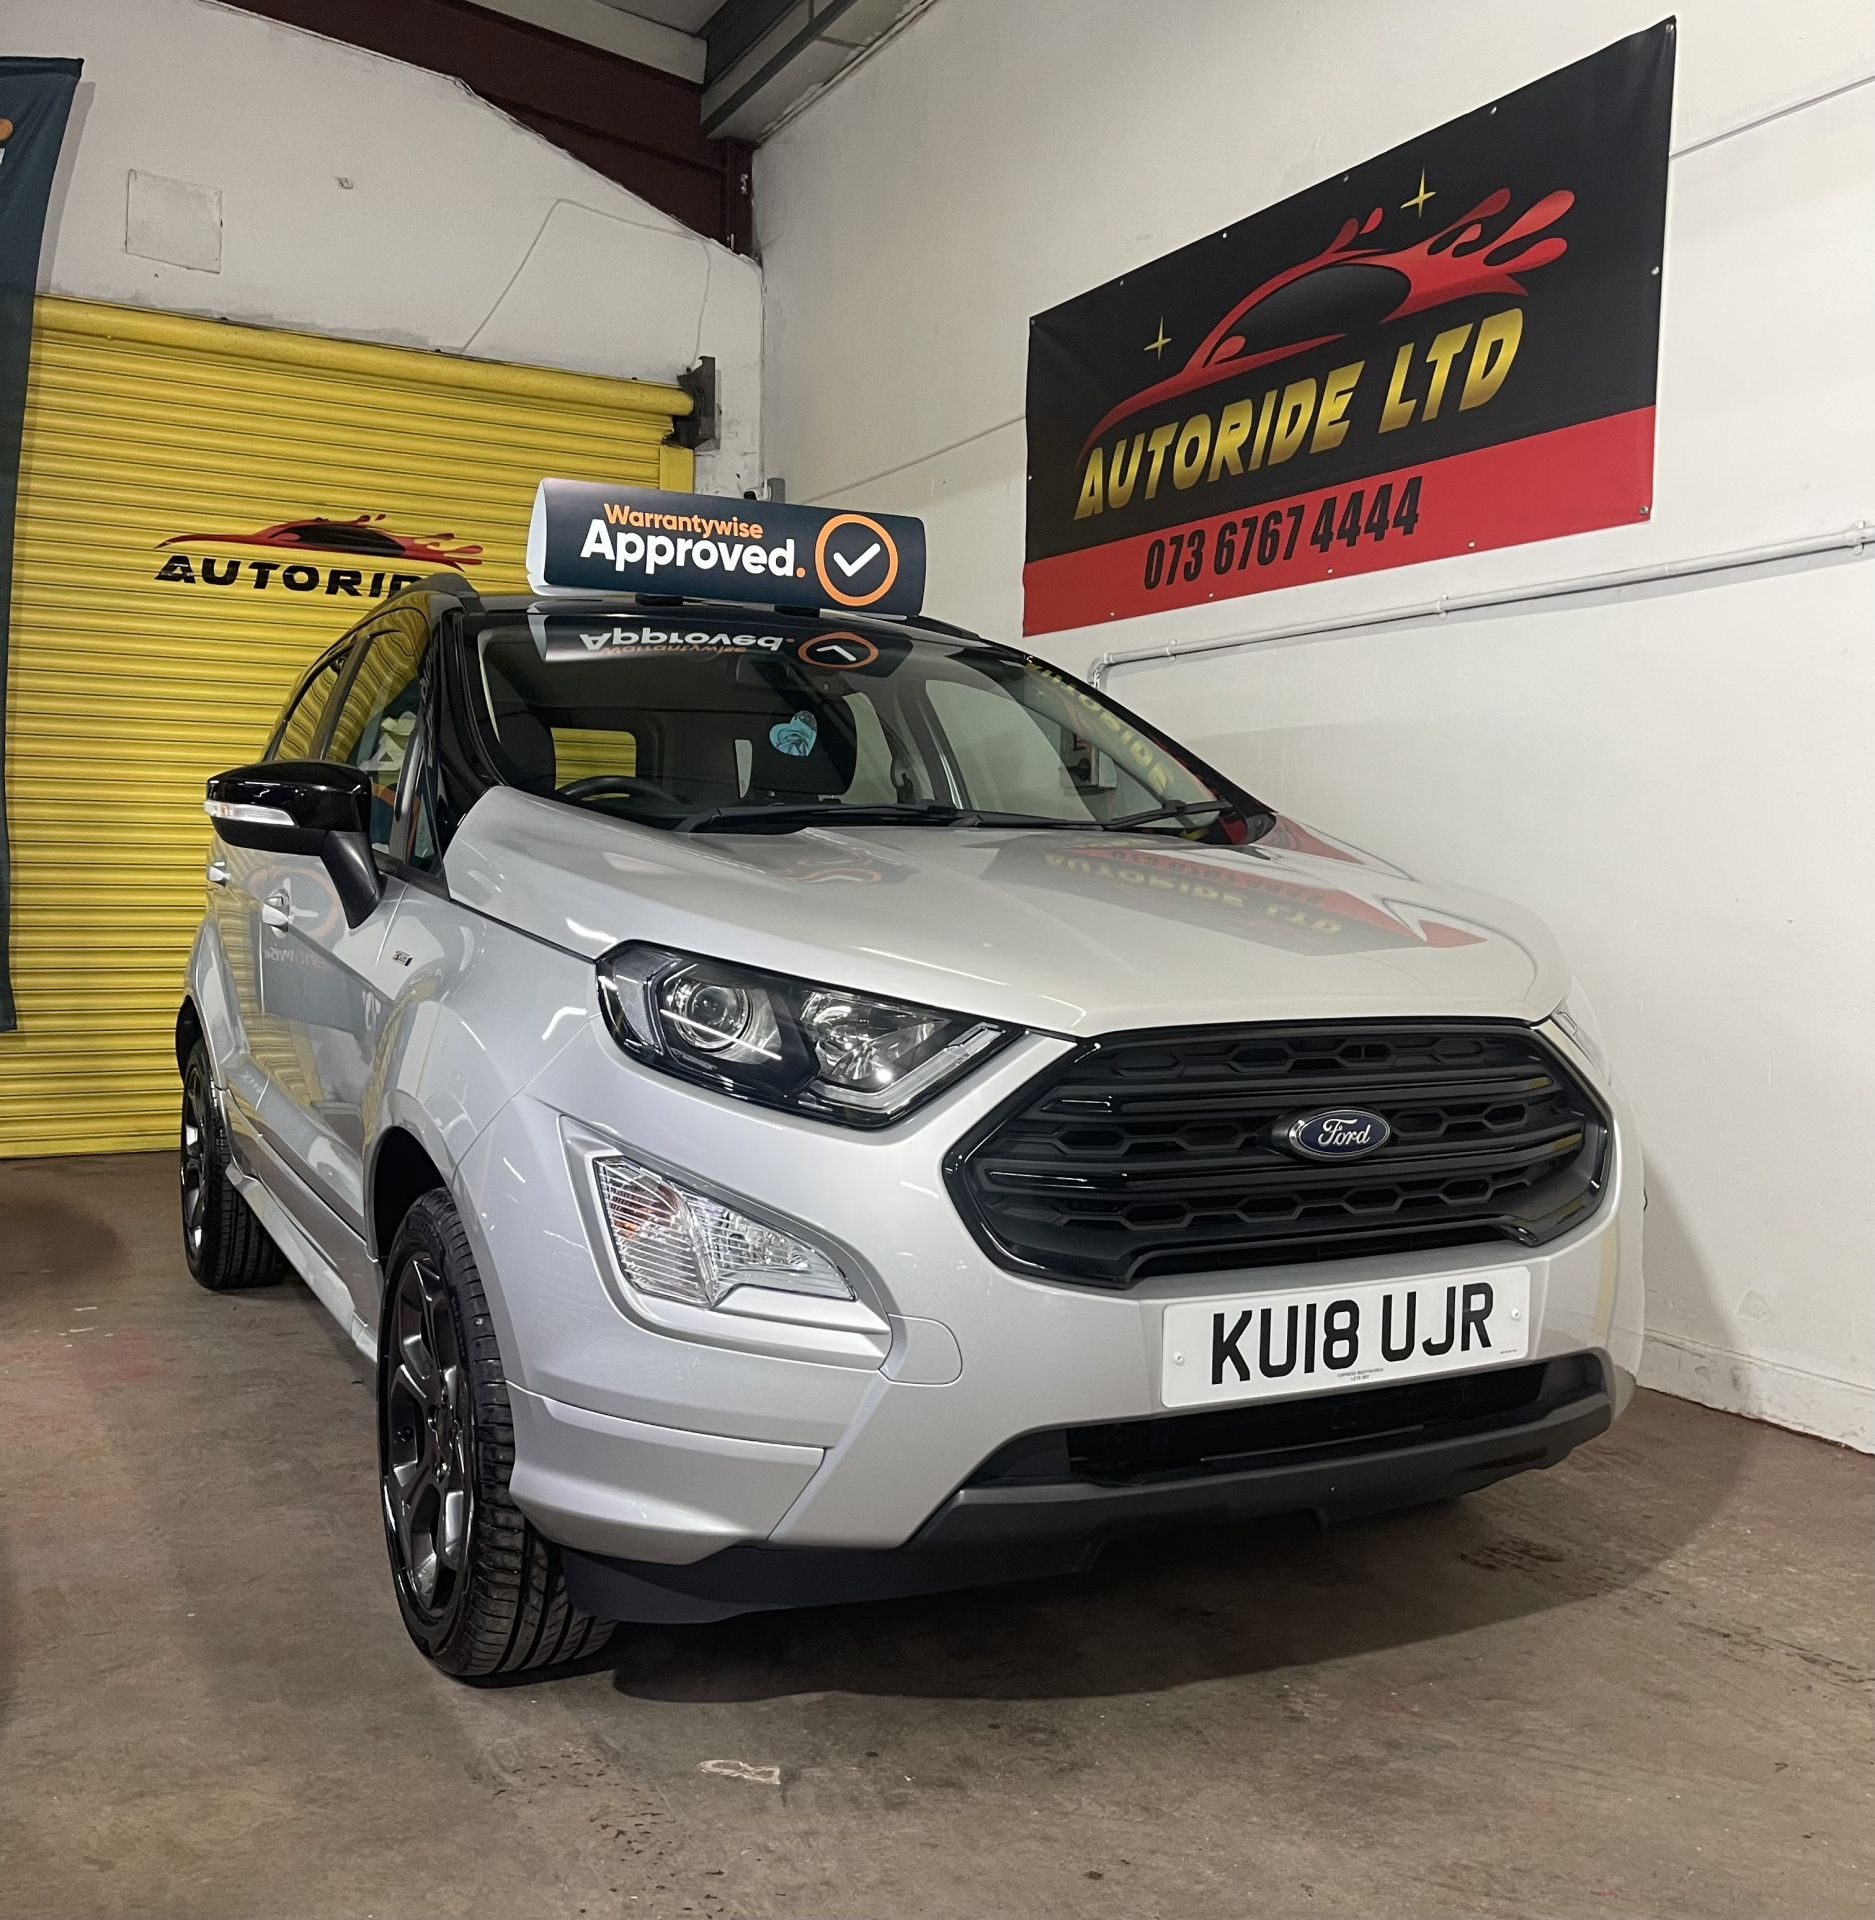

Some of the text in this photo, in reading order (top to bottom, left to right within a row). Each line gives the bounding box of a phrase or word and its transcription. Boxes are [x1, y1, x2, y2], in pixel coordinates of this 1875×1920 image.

[1073, 307, 1524, 521] AUTORIDE LTD
[580, 518, 806, 578] Approved.
[604, 503, 764, 540] Warrantywise
[1143, 475, 1423, 590] 073 6767 4444
[1317, 1118, 1372, 1148] Ford
[1211, 1281, 1494, 1385] KU18 UJR
